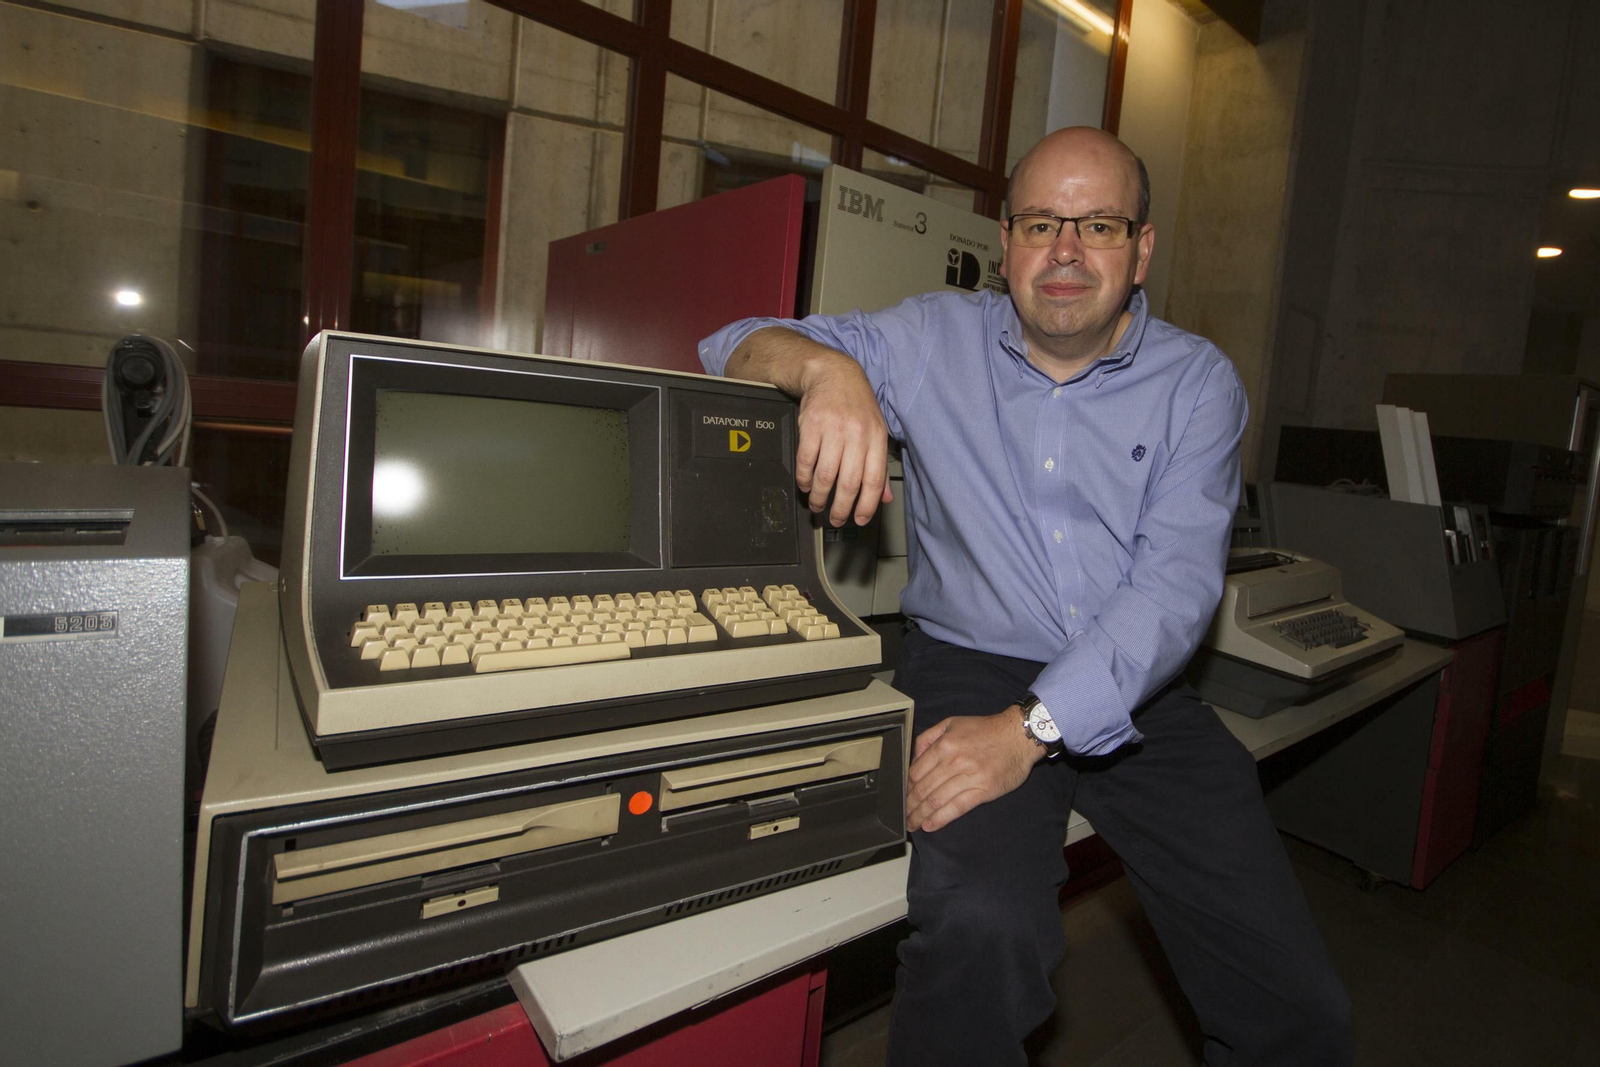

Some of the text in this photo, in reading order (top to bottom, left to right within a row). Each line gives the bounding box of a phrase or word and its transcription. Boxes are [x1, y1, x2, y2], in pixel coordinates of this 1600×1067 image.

[838, 185, 885, 222] IBM
[915, 212, 927, 234] 3
[950, 234, 976, 247] DONADO
[703, 415, 775, 430] DATAPOINT 1500
[55, 614, 112, 632] 5203
